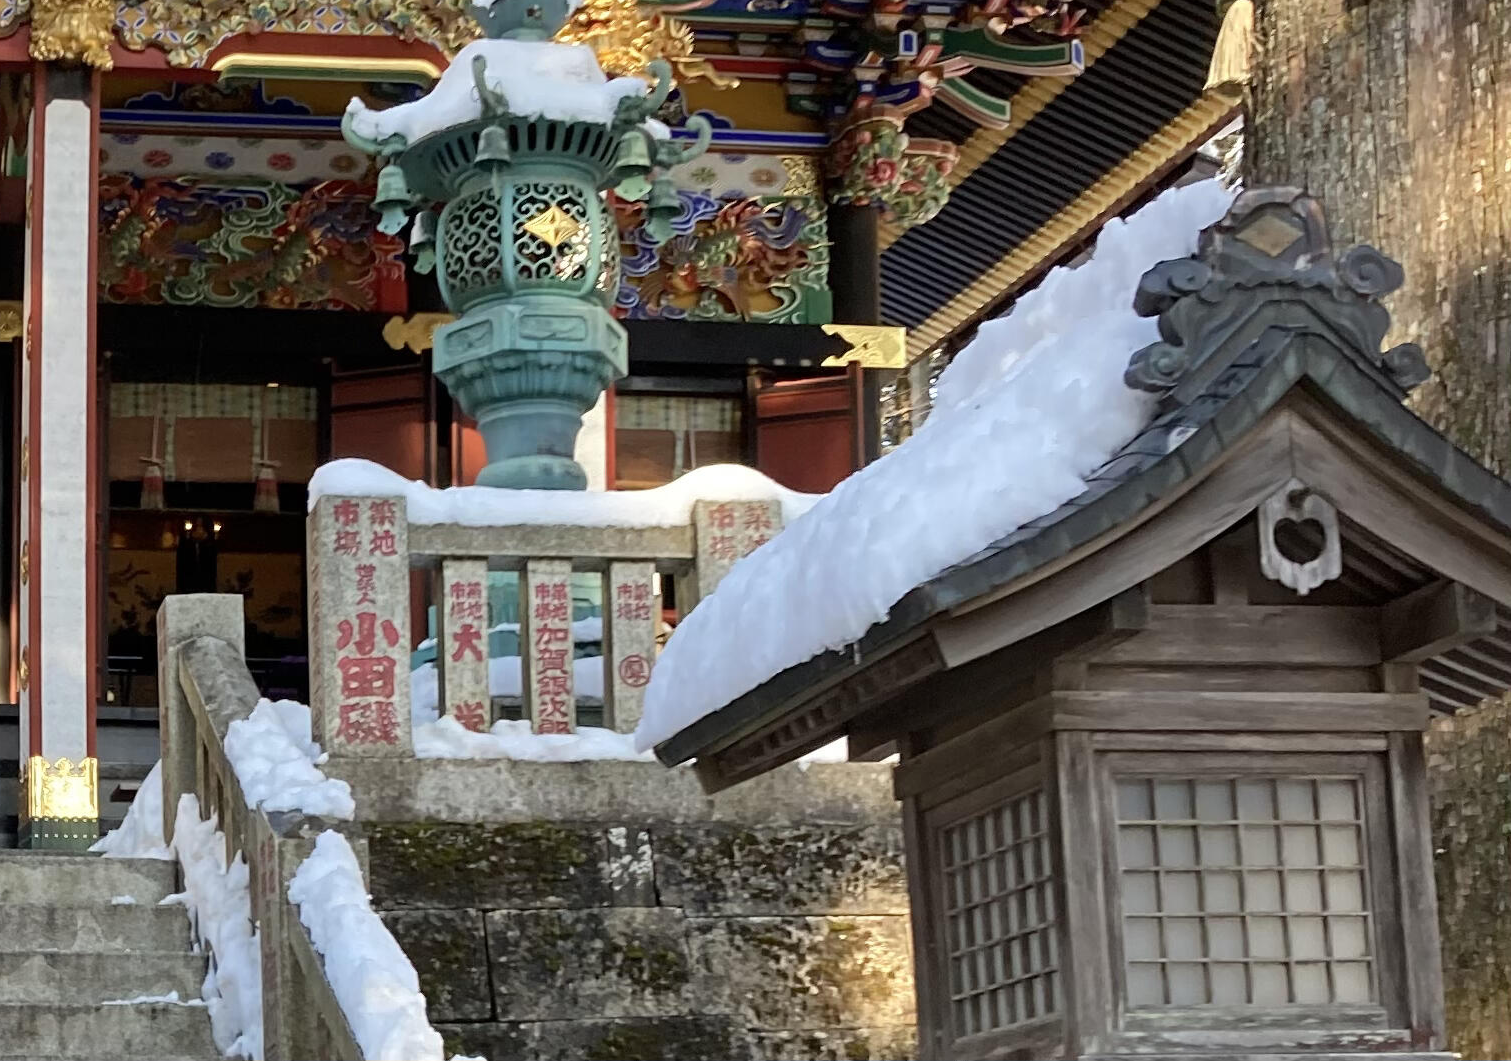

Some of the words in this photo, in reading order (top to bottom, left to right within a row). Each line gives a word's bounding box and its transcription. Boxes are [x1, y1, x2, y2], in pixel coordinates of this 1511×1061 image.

[333, 499, 362, 557] 市場
[368, 499, 398, 558] 築地
[335, 611, 401, 746] 小田磯
